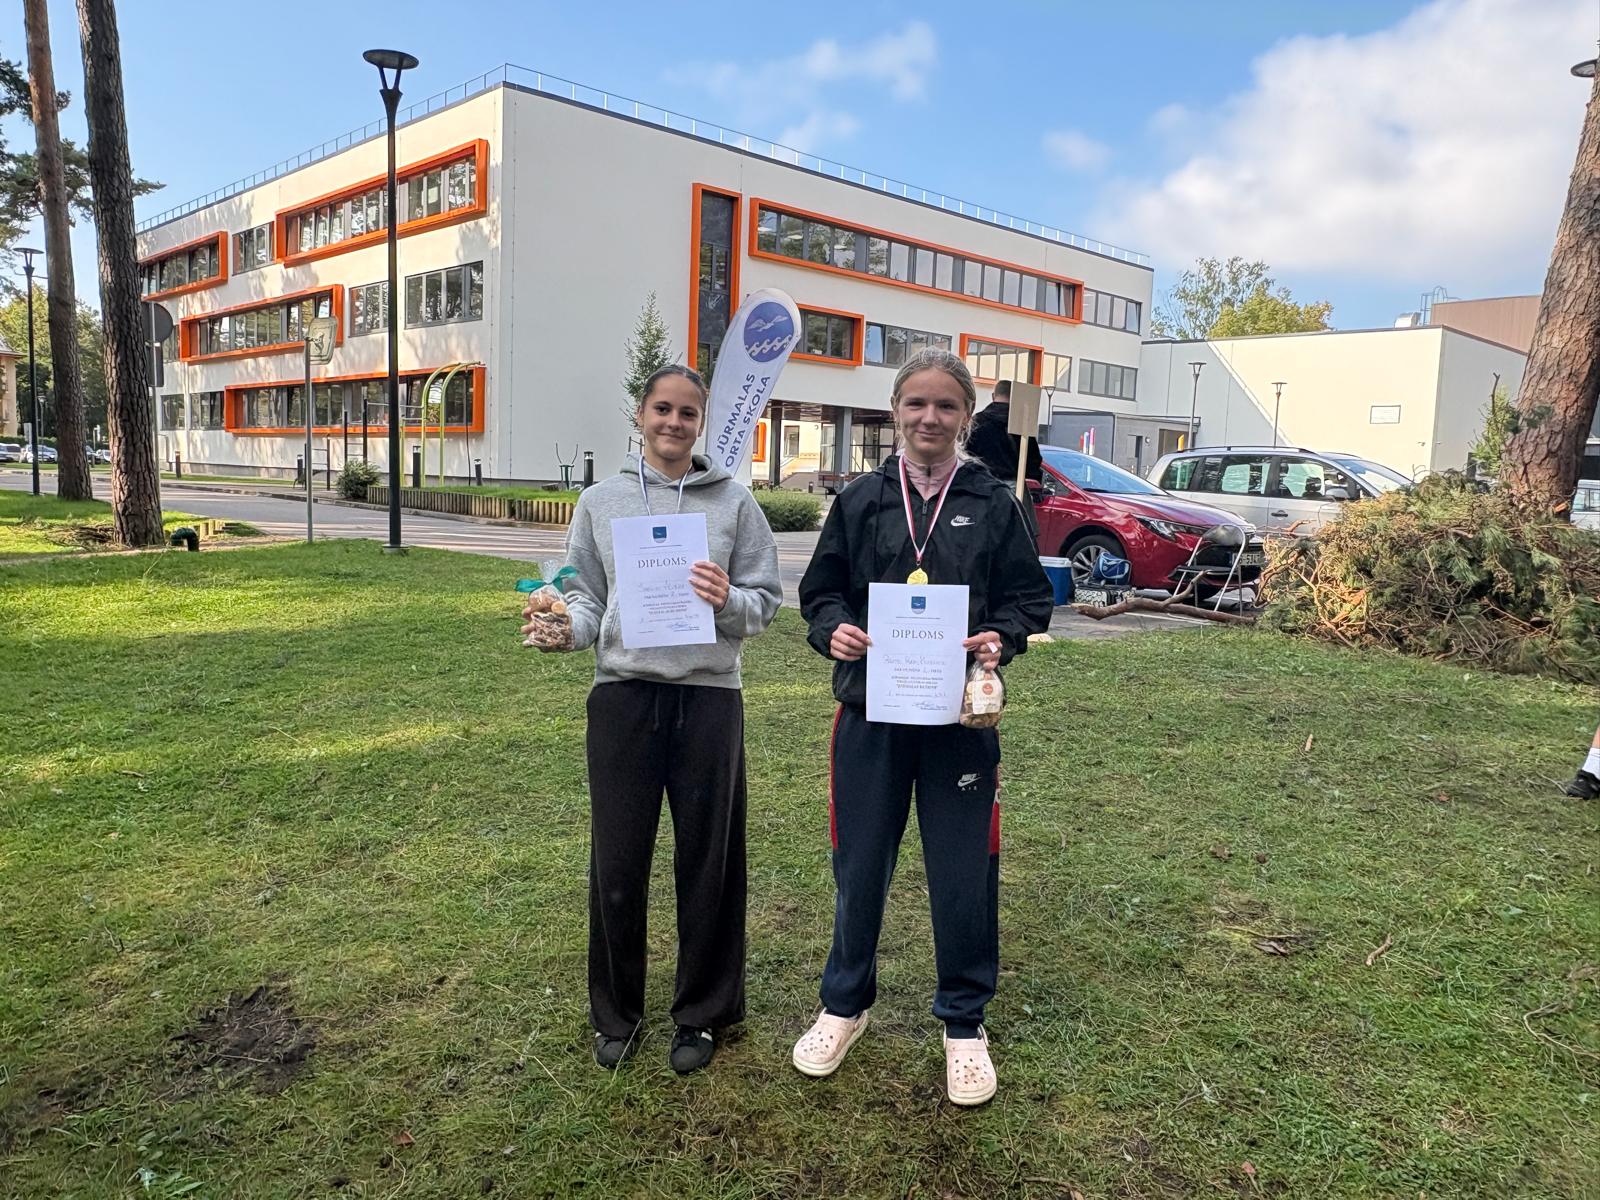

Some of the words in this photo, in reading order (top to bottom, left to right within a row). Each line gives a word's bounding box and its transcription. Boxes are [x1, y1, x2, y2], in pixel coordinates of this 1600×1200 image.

[716, 373, 755, 455] JŪRMALAS
[743, 375, 771, 425] SKOLA
[638, 556, 687, 569] DIPLOMS
[891, 628, 944, 640] DIPLOMS
